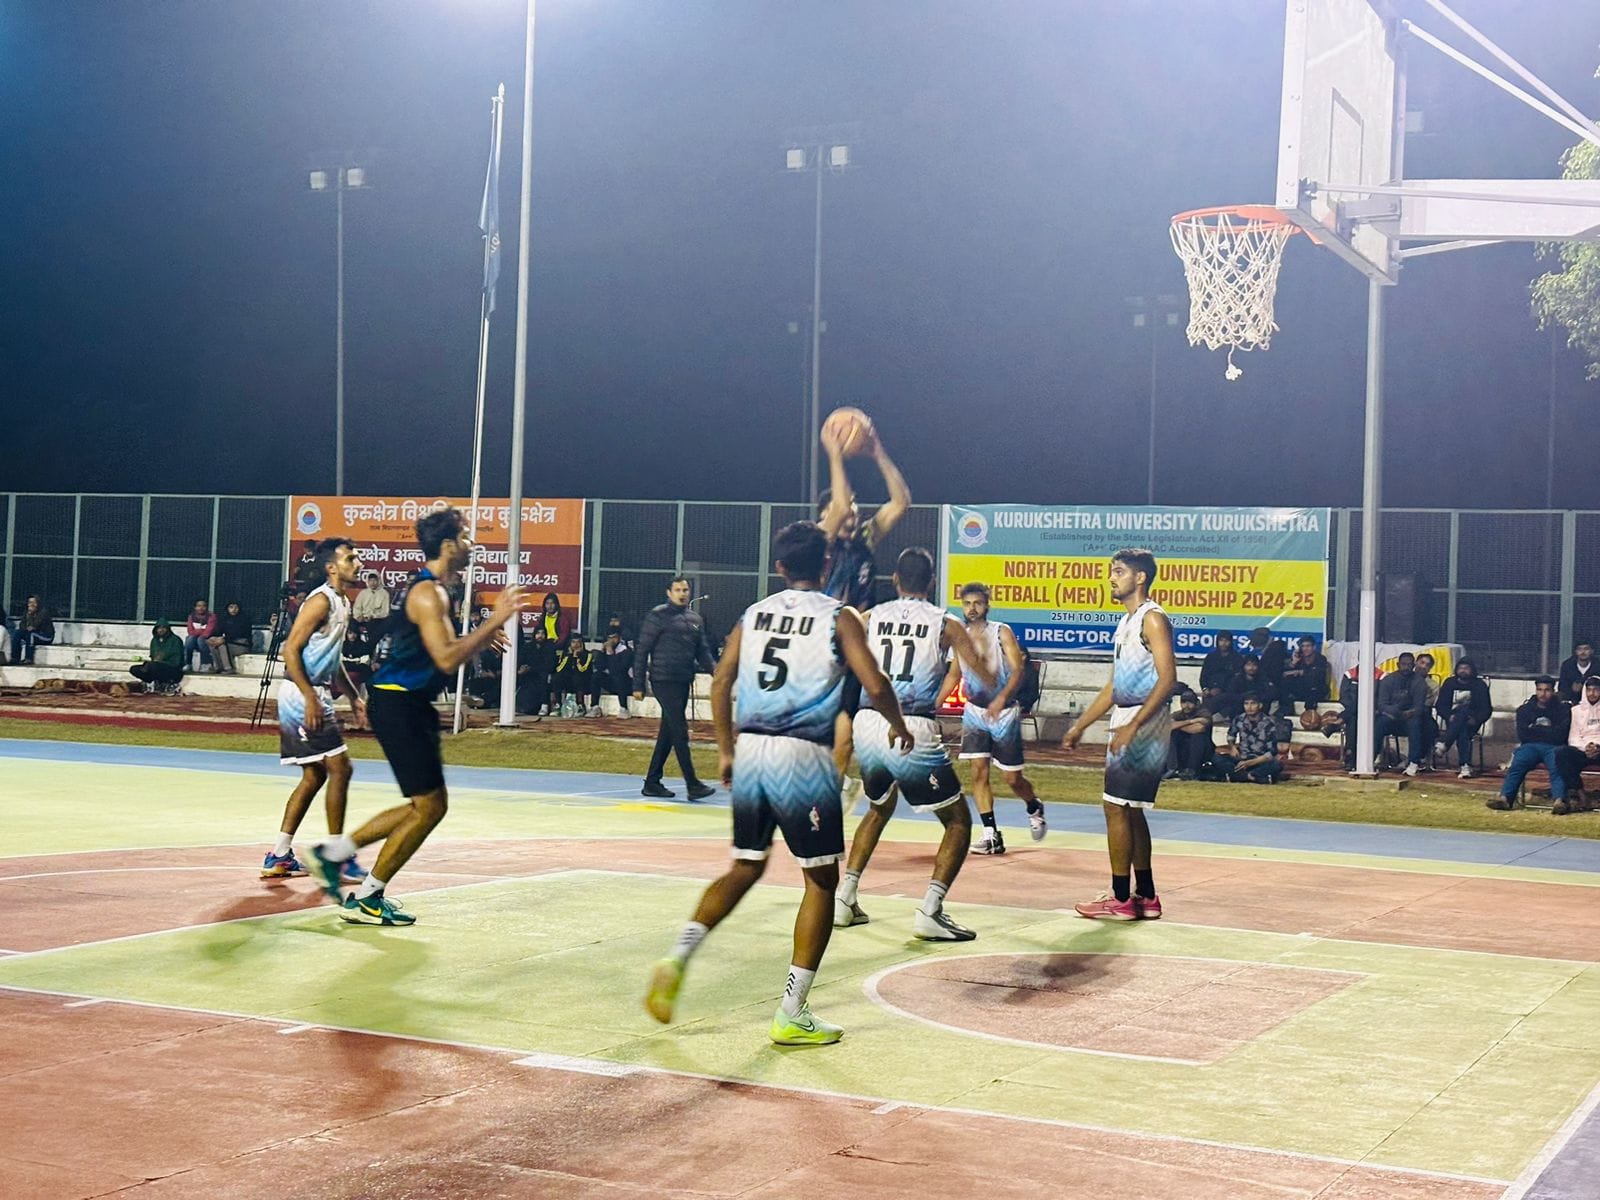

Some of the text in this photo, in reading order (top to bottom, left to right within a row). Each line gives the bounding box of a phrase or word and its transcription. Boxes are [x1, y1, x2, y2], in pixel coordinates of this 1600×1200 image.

[343, 500, 399, 527] कुरुक्षेत्र
[994, 511, 1319, 532] KURUKSHETRA UNIVERSITY KURUKSHETRA
[1095, 533, 1105, 543] by
[1107, 533, 1122, 542] the
[1123, 534, 1145, 542] State
[1147, 534, 1198, 544] Legislature
[1200, 534, 1216, 543] Act
[519, 574, 558, 586] 024-25
[1004, 561, 1057, 579] NORTH
[1062, 562, 1103, 580] ZONE
[1159, 564, 1259, 584] UNIVERSITY
[953, 583, 1050, 603] BKETBALL
[1055, 583, 1105, 607] (MEN)
[1241, 592, 1314, 611] 2024-25
[754, 611, 815, 636] M.D.U
[877, 621, 929, 638] M.D.U
[1051, 612, 1075, 622] 25TH
[1078, 613, 1092, 622] TO
[1095, 613, 1106, 622] 30
[1182, 616, 1206, 625] 2024
[1024, 628, 1115, 644] DIRECTOR
[1177, 633, 1254, 652] SPOS,
[757, 637, 792, 692] 5
[880, 638, 916, 682] 11
